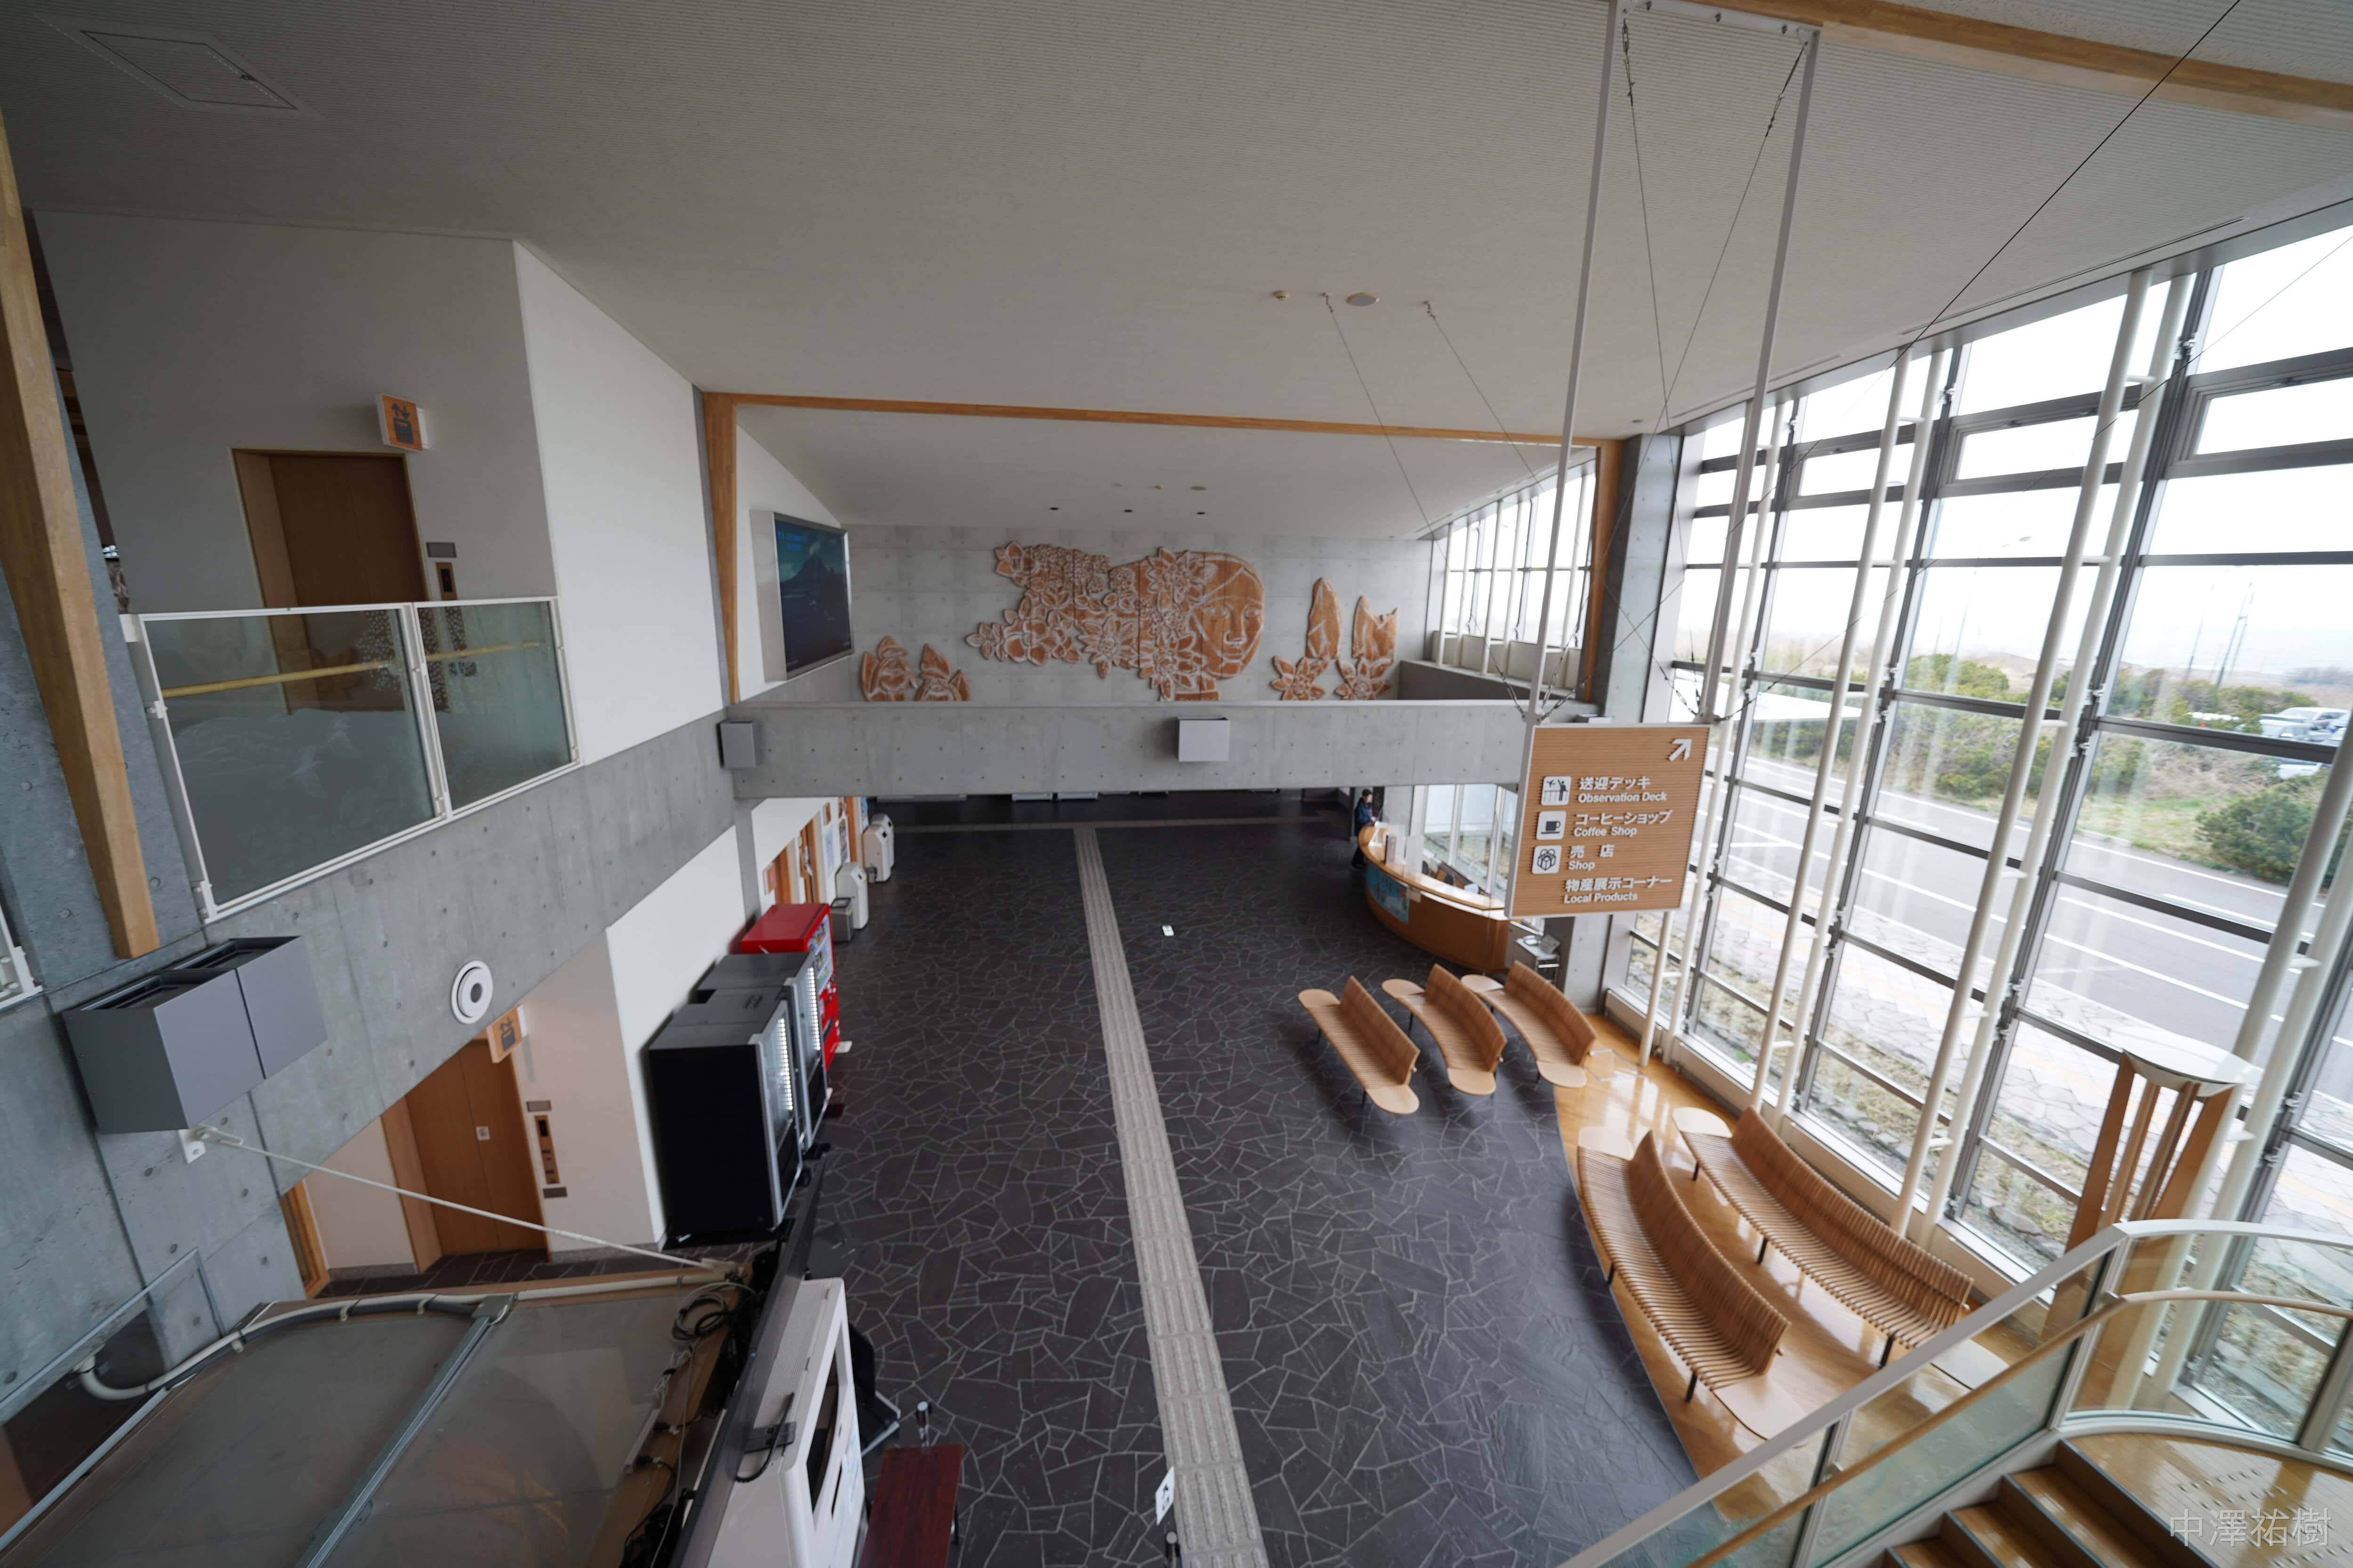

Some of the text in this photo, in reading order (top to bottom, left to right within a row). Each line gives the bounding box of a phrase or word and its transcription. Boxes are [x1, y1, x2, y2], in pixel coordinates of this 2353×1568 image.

[1579, 776, 1651, 790] 送迎デッキ
[1578, 792, 1667, 803] Observation Deck
[1575, 809, 1673, 825] コーヒーショップ
[1574, 826, 1638, 838] Coffee Shop
[1568, 860, 1595, 871] Shop
[1565, 876, 1672, 892] 物産展示コーナー
[1564, 892, 1638, 904] Local Products
